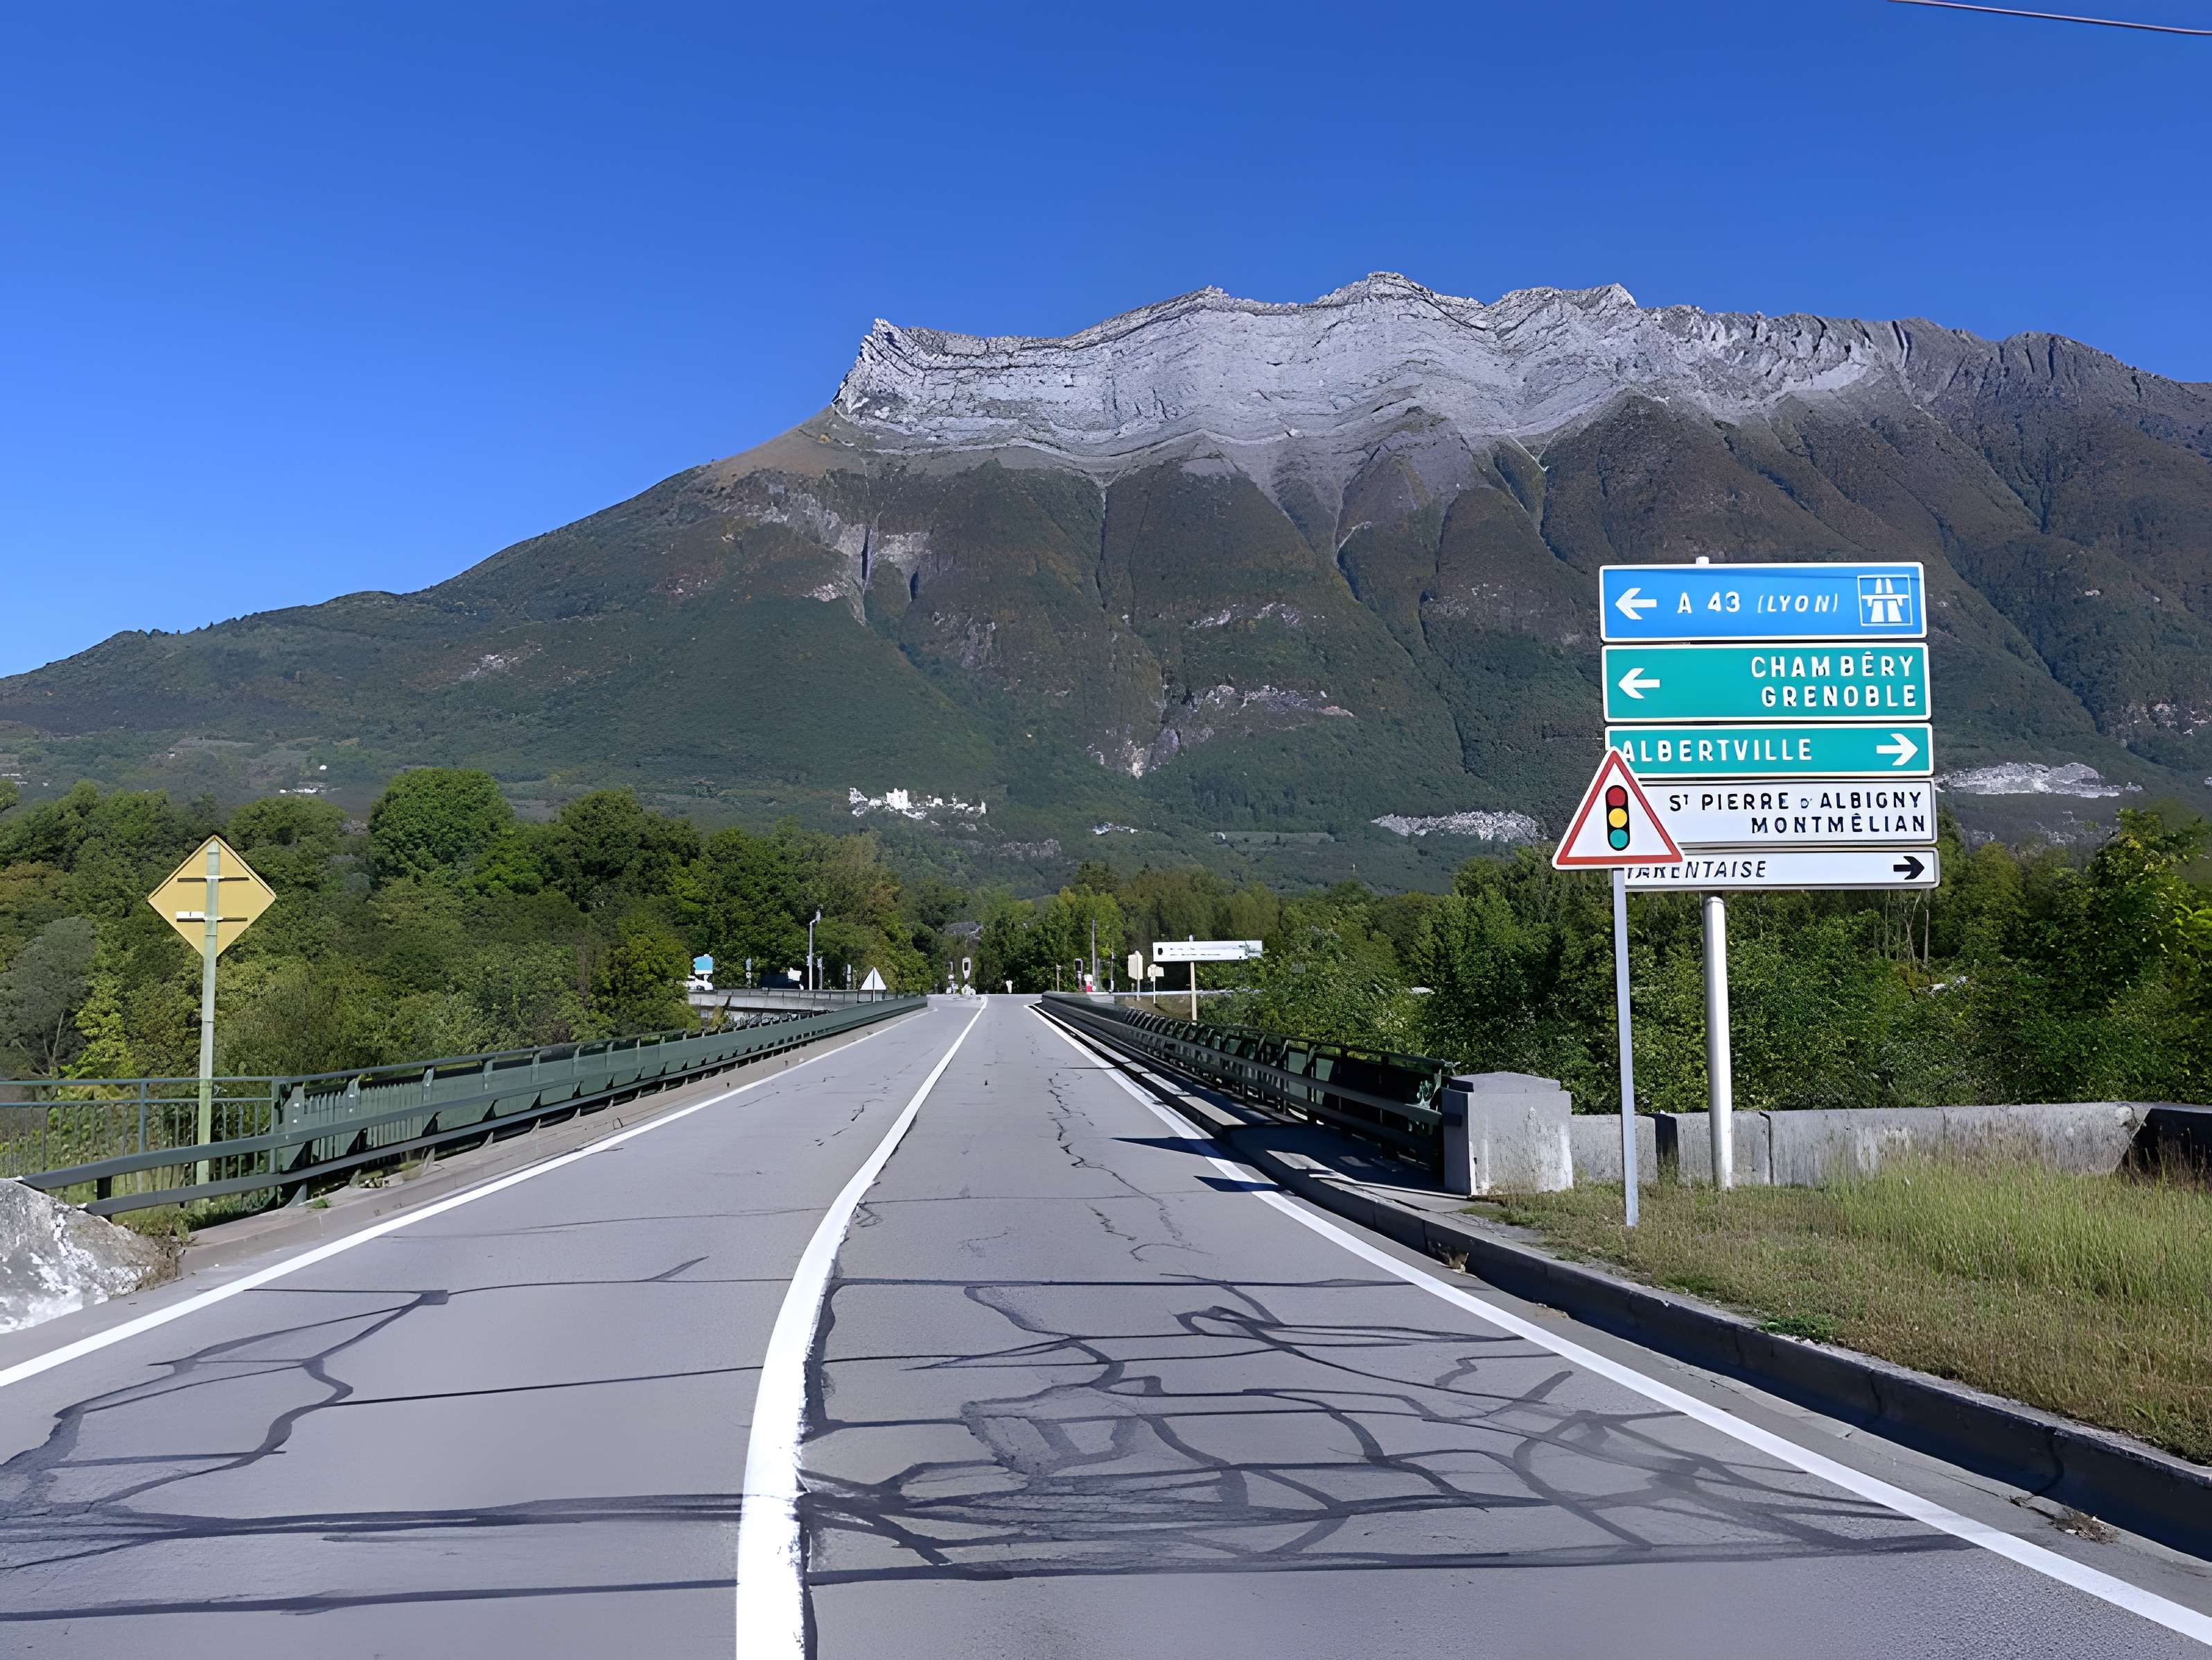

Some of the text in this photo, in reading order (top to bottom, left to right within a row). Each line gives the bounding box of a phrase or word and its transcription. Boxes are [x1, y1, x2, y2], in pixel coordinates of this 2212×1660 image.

[1677, 591, 1838, 614] A 43 (LYON)
[1761, 685, 1916, 707] GRENOBLE
[1622, 739, 1812, 762] ALBERTVILLE
[1701, 792, 1789, 811] PIERRE
